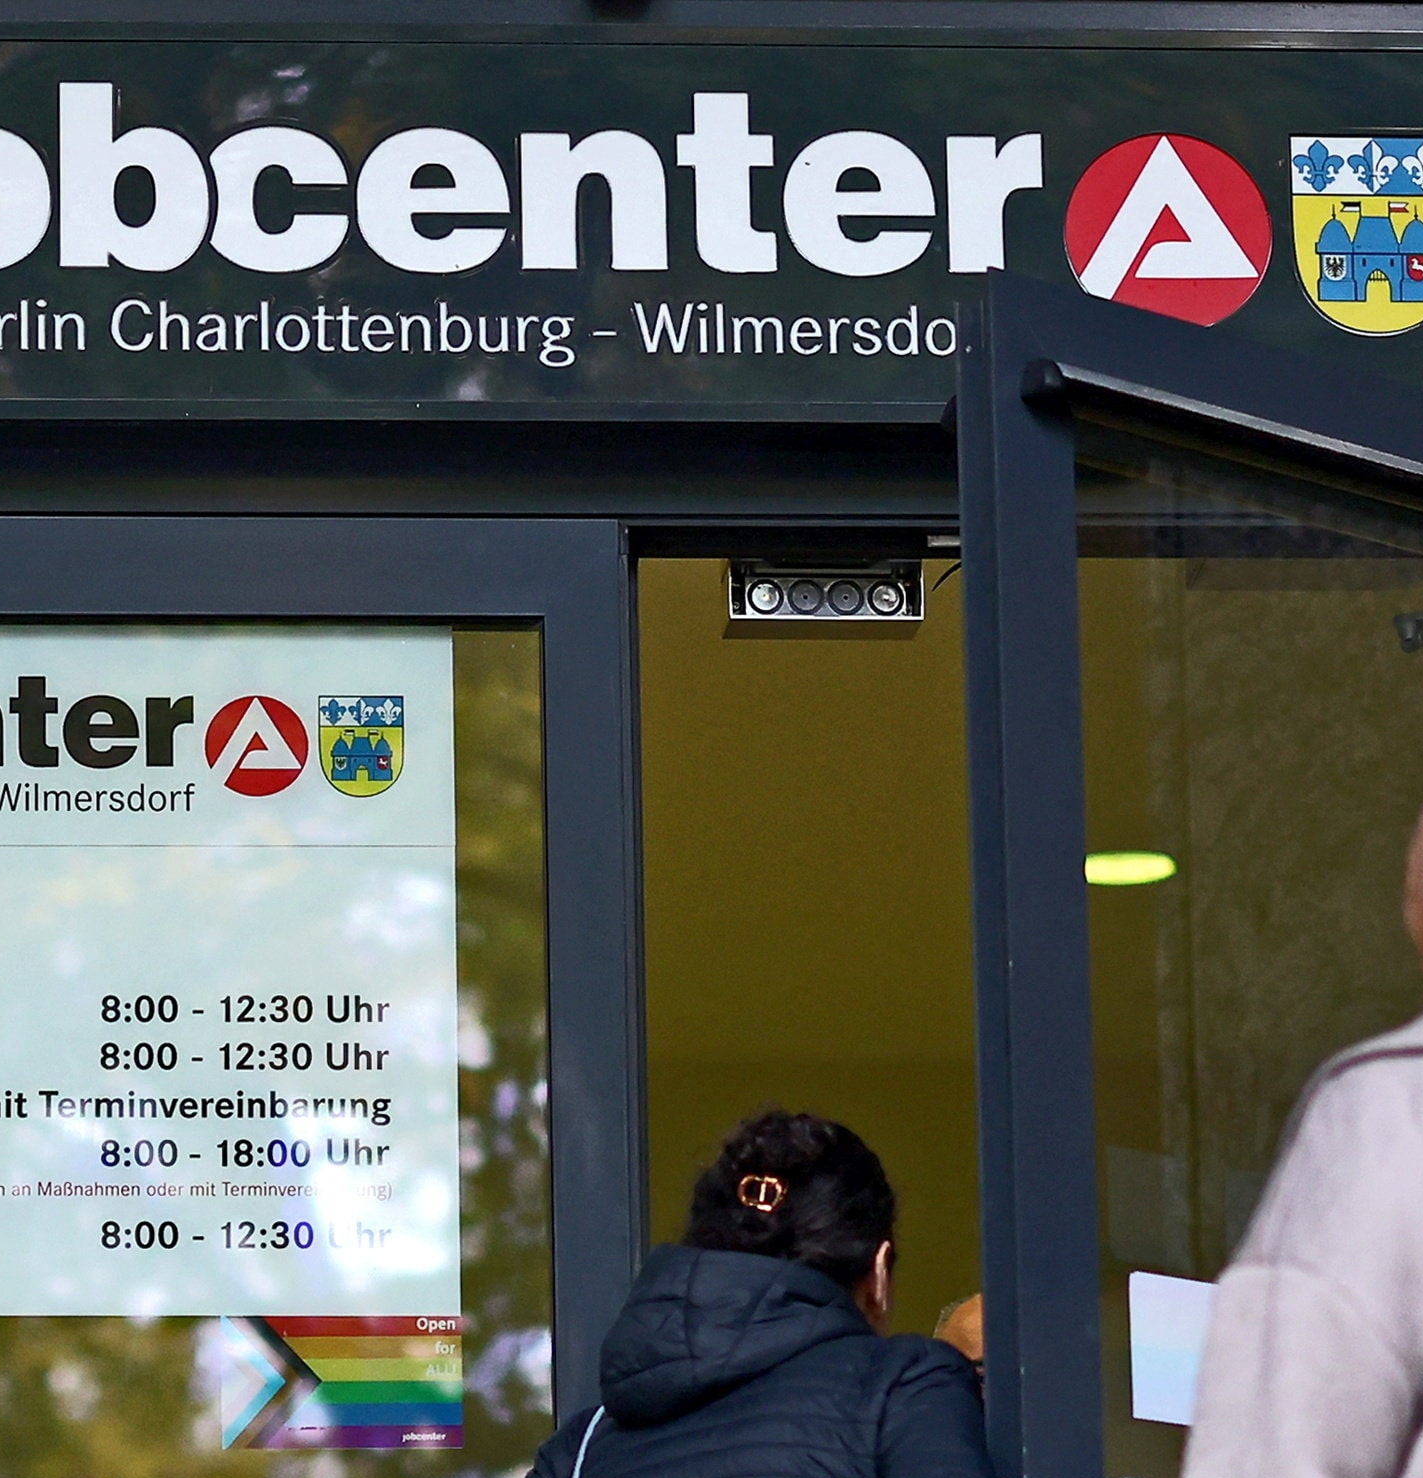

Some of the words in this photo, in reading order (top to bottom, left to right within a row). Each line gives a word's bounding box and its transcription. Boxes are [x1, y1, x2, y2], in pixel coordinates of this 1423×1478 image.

[110, 296, 575, 367] Charlottenburg
[630, 300, 957, 356] Wilmersdo
[100, 994, 179, 1024] 8:00
[219, 994, 314, 1024] 12:30
[326, 994, 390, 1024] Uhr
[99, 1041, 178, 1071] 8:00
[218, 1041, 313, 1071] 12:30
[326, 1041, 390, 1071] Uhr
[38, 1089, 392, 1127] Terminvereinbarung
[100, 1138, 178, 1168] 8:00
[216, 1138, 311, 1168] 18:00
[326, 1138, 391, 1167] Uhr
[11, 1184, 32, 1198] an
[37, 1180, 141, 1198] Maßnahmen
[146, 1181, 185, 1198] oder
[189, 1181, 217, 1198] mit
[100, 1220, 179, 1250] 8:00
[220, 1220, 315, 1250] 12:30
[416, 1317, 456, 1333] Open
[434, 1340, 456, 1355] for
[402, 1432, 447, 1443] jobcenter
